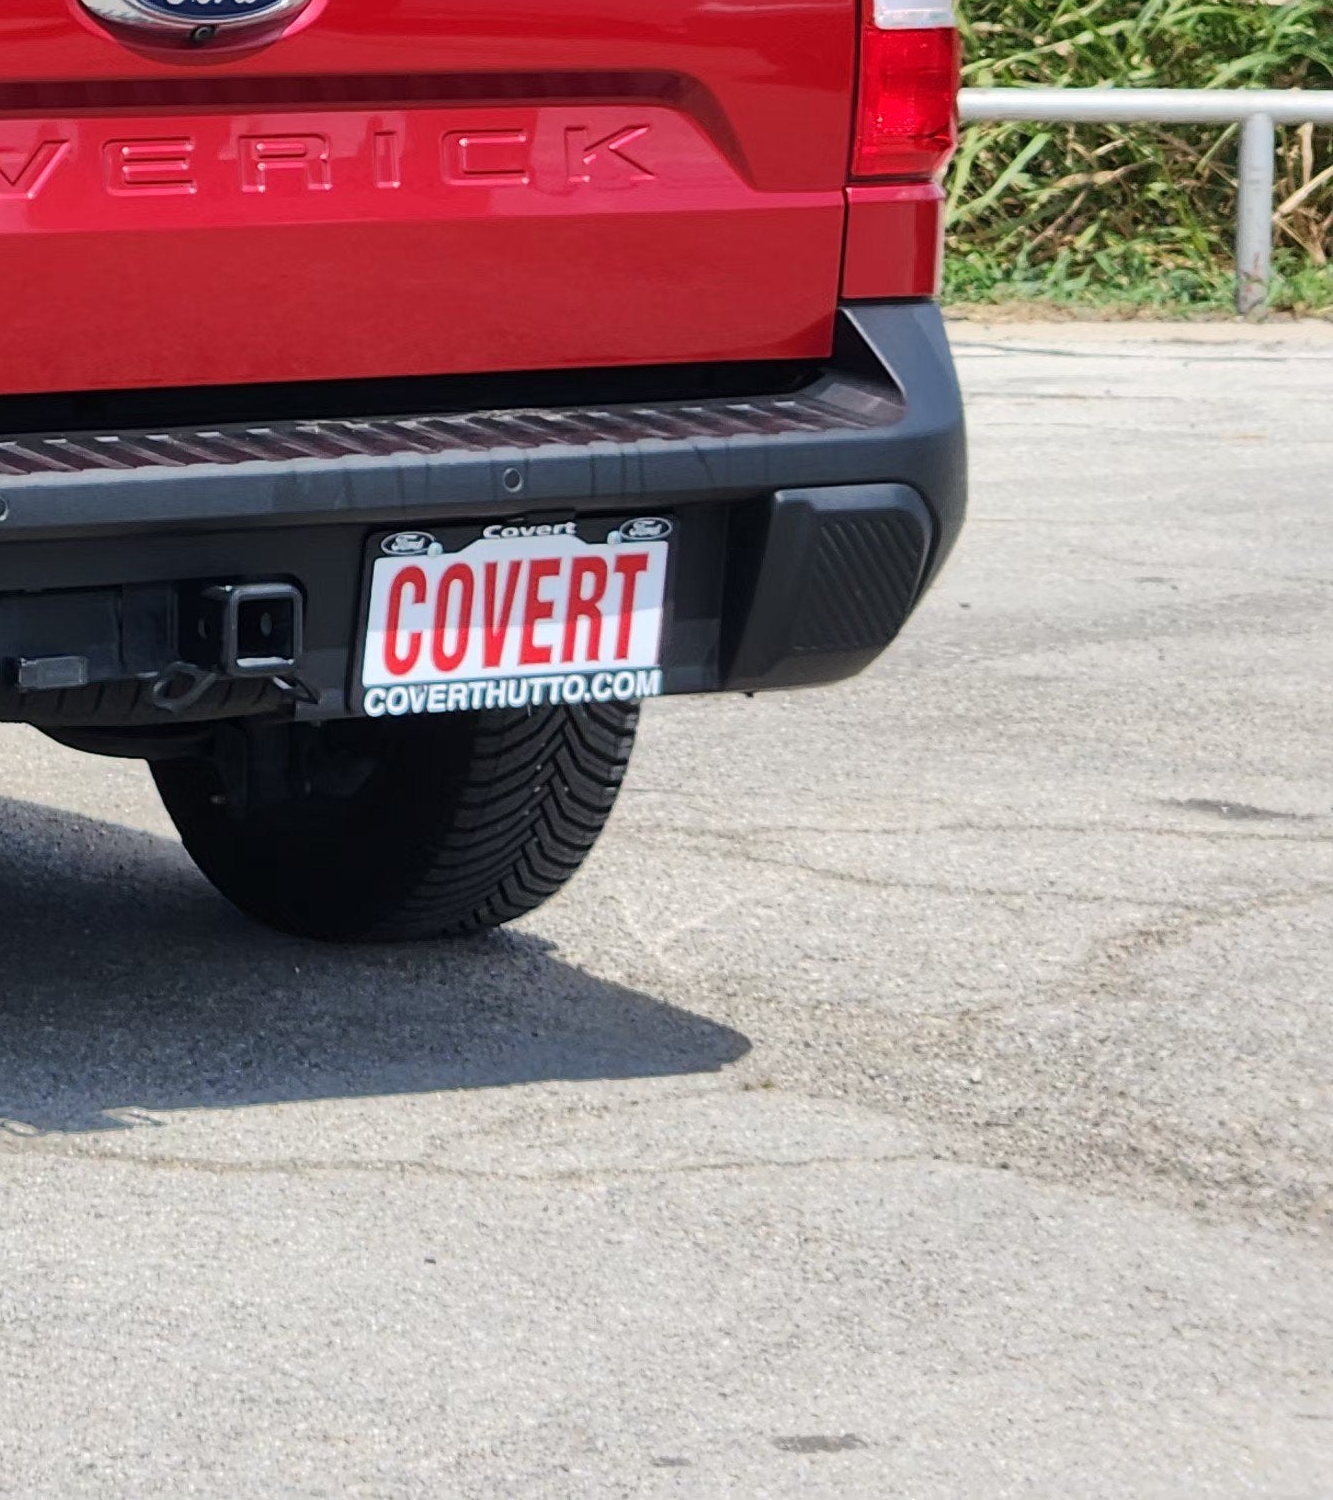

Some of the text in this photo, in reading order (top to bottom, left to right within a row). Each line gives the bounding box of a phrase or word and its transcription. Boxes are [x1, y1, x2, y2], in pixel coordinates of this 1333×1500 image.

[482, 521, 578, 540] Covert
[383, 552, 650, 677] COVERT
[363, 669, 662, 717] COVERTHUTTO.COM
